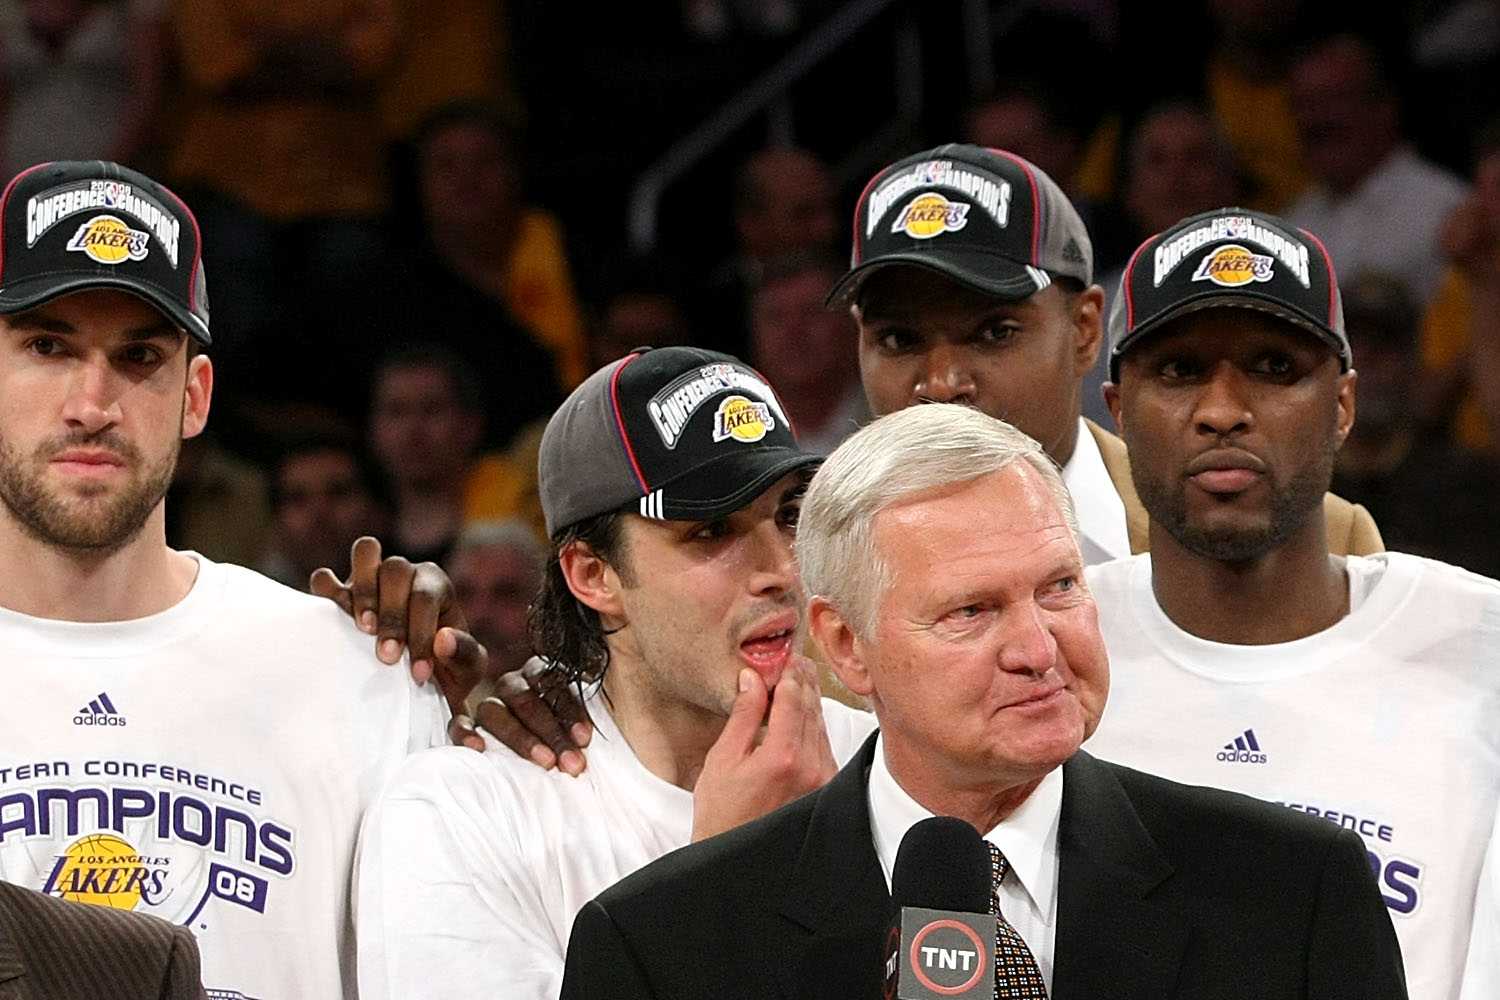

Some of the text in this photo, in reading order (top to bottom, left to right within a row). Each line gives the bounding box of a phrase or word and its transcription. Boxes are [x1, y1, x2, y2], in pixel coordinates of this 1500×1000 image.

[939, 169, 1010, 225] CHAMPIONS
[27, 190, 180, 266] CONFERENCE CHAMPIONS
[898, 206, 964, 227] LAKERS
[75, 227, 147, 256] LAKERS
[1154, 225, 1310, 288] CONFERENCE CHAMPIONS
[1201, 258, 1272, 280] LAKERS
[649, 375, 721, 446] CONFERENCE
[720, 409, 771, 437] LAKERS
[73, 712, 127, 727] adidas
[1216, 750, 1267, 764] adidas
[0, 761, 261, 805] TERN CONFERENCE
[0, 788, 293, 876] AMPIONS
[78, 855, 171, 866] LOS ANGELES
[42, 856, 173, 906] LAKERS
[216, 869, 256, 903] 08
[921, 946, 976, 971] TNT
